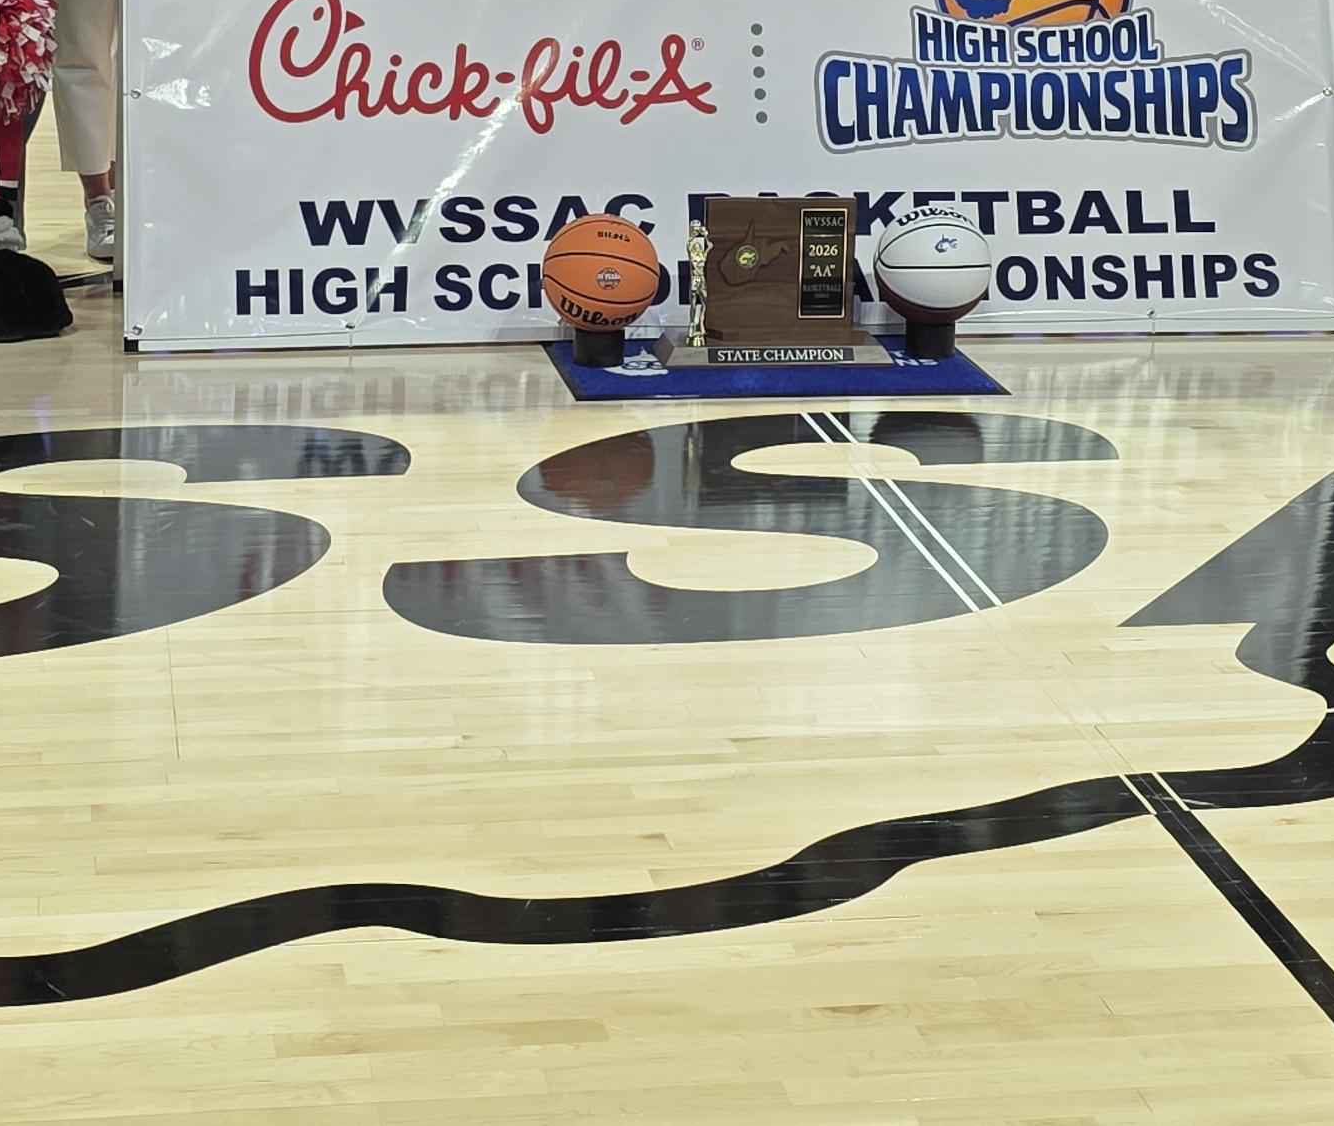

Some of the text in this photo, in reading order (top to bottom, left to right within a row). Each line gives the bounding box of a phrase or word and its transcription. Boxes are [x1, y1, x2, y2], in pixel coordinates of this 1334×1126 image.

[914, 10, 1159, 64] HIGH SCHOOL
[821, 56, 1252, 144] CHAMPIONSHIPS
[299, 193, 656, 247] WVSSAC
[804, 216, 844, 227] WVSSAC
[808, 244, 838, 258] 2026
[809, 264, 836, 277] "AA"
[235, 265, 410, 315] HIGH
[559, 293, 639, 327] Wilson
[717, 348, 845, 363] STATE CHAMPION
